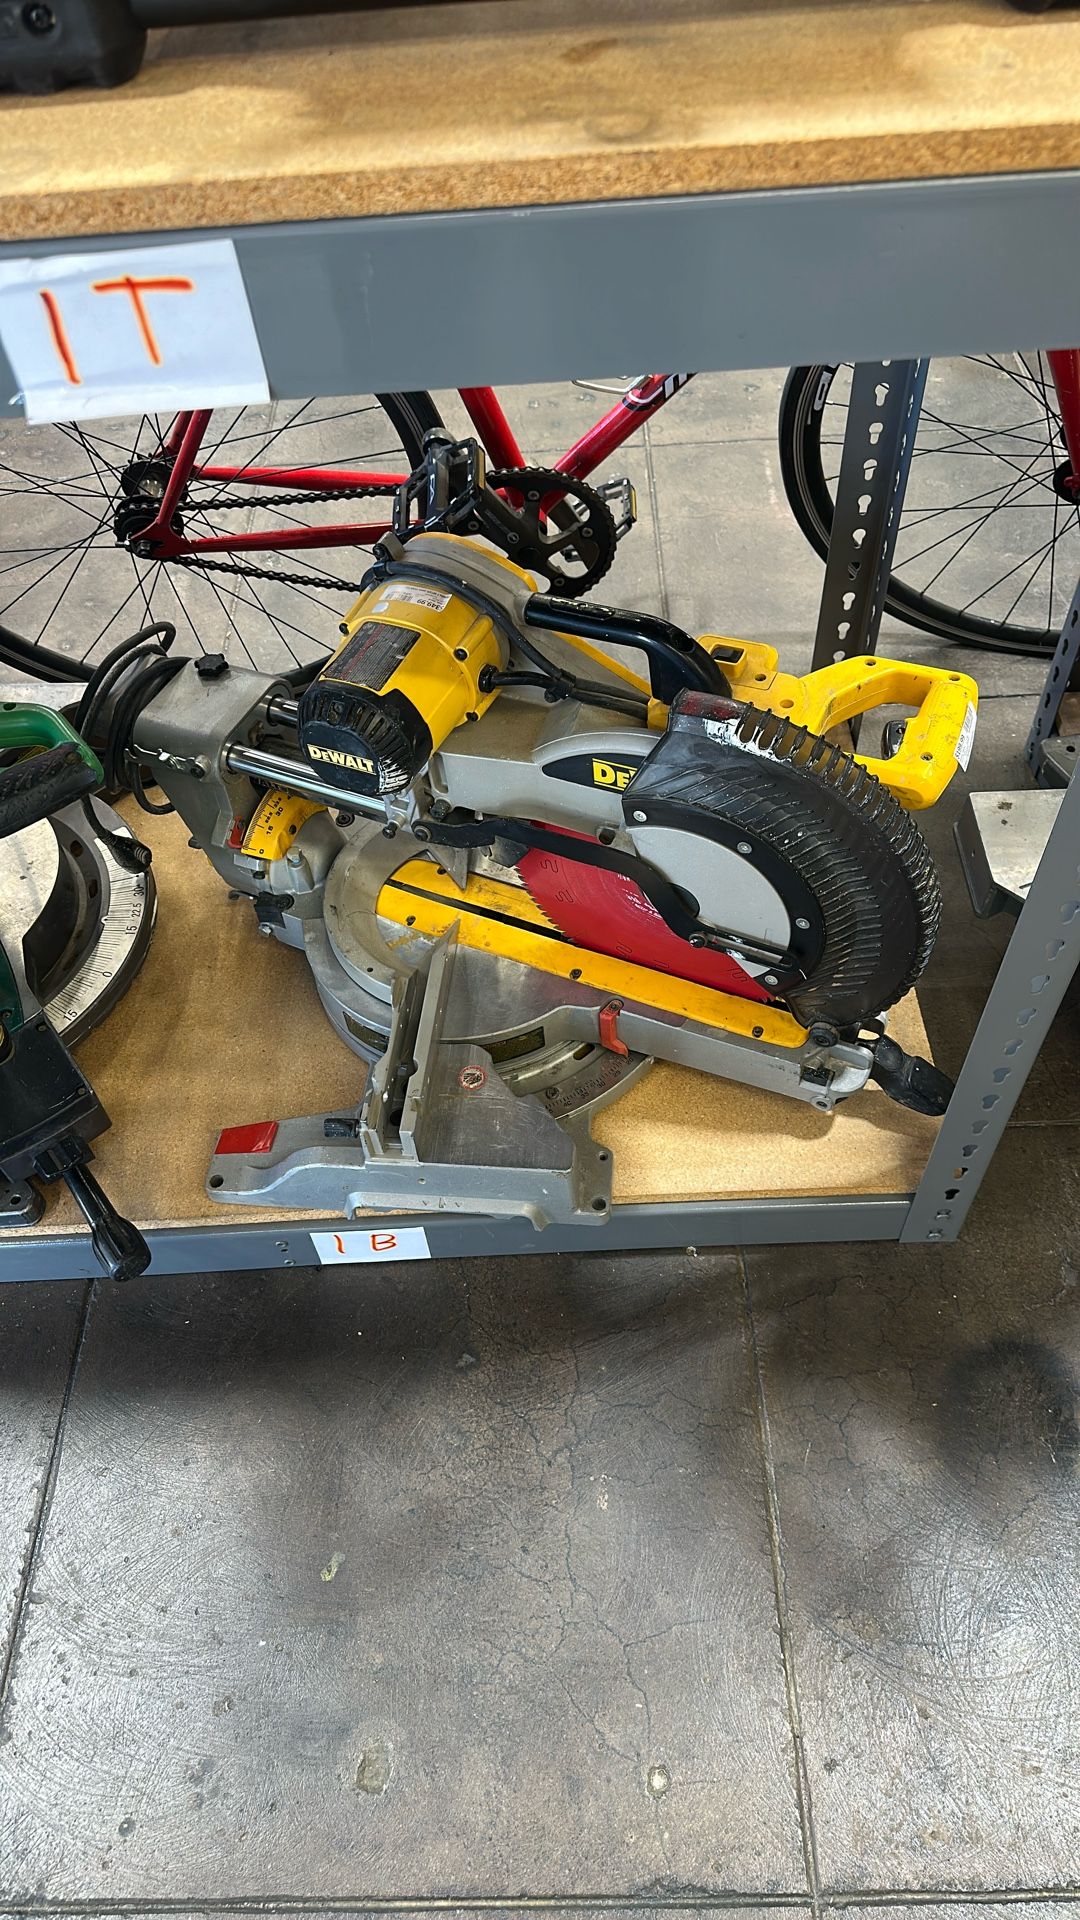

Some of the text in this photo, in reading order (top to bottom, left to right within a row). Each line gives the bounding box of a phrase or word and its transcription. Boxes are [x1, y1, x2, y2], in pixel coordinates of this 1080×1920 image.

[63, 885, 145, 1022] 15 0 15 22.5 30
